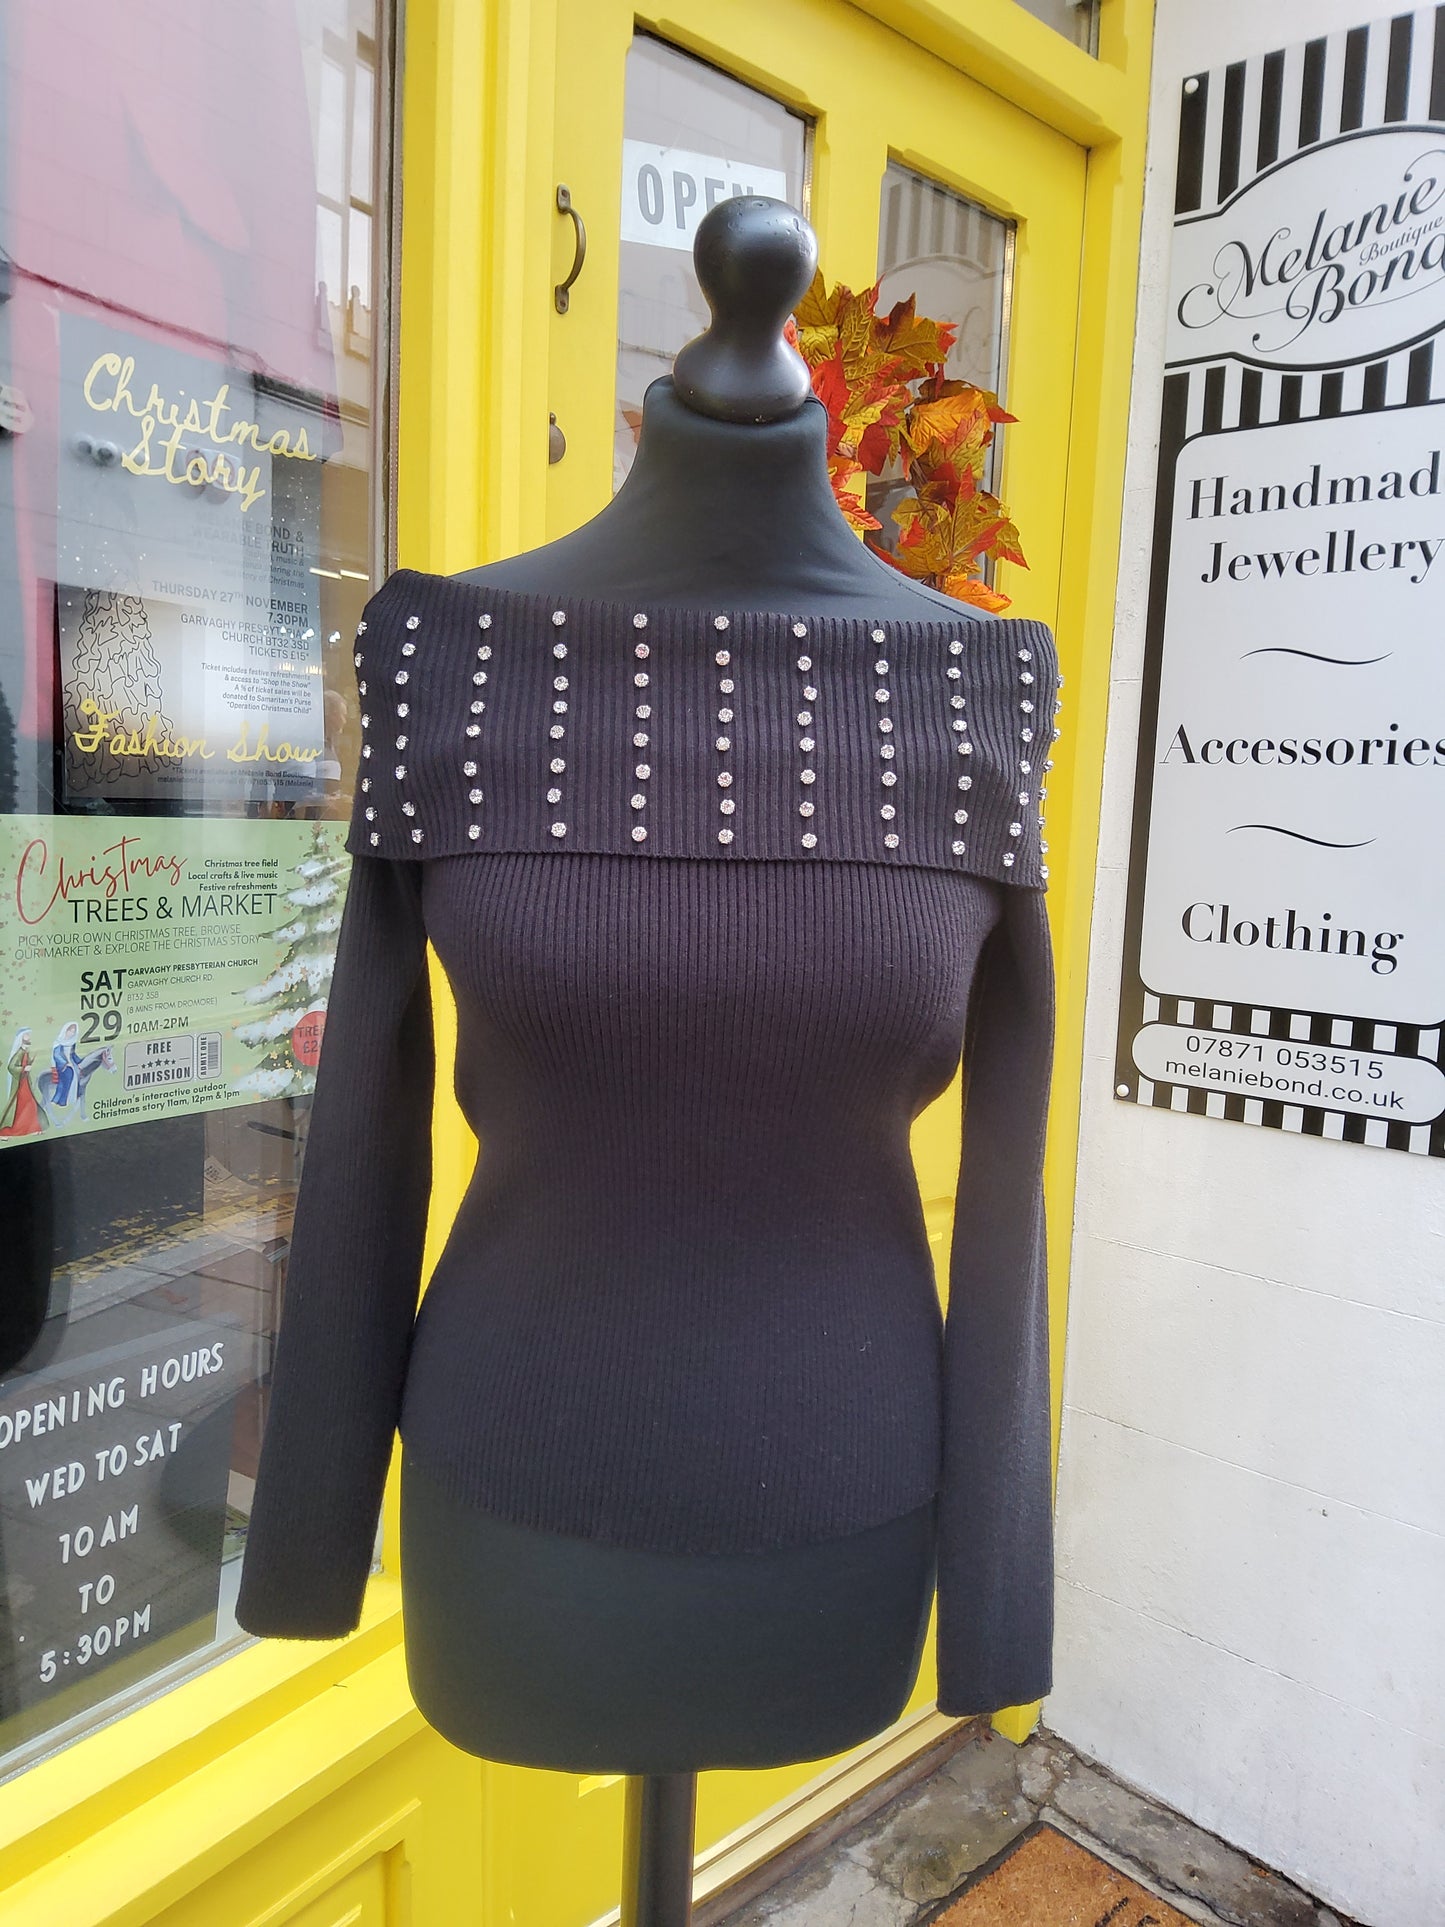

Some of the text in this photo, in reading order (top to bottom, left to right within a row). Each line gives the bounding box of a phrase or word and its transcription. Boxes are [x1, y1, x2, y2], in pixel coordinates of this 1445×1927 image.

[637, 163, 754, 230] OPE
[1178, 150, 1445, 328] Melanie
[1359, 215, 1444, 266] Boutique
[84, 353, 317, 461] Christmas
[121, 415, 266, 512] Story
[1186, 450, 1442, 520] Handmad
[255, 522, 291, 540] BOND
[295, 531, 304, 543] &
[1200, 529, 1445, 584] Jewellery
[152, 580, 217, 600] THURSDAY
[246, 595, 308, 614] NOVEMBER
[181, 613, 235, 630] GARVAGHY
[267, 612, 308, 628] 7.30PM
[222, 631, 263, 646] CHURCH
[266, 635, 289, 649] BT32
[249, 646, 288, 660] TICKETS
[201, 662, 311, 681] Ticket includes festive refreshments
[230, 675, 252, 683] access
[281, 679, 291, 687] the
[222, 692, 311, 706] donated to Samaritan's Purse
[247, 685, 255, 693] of
[255, 686, 273, 694] ticket
[274, 688, 290, 696] sales
[292, 689, 302, 697] will
[303, 690, 311, 698] be
[261, 705, 292, 713] Christmas
[73, 698, 322, 763] Fashion Show
[1159, 722, 1445, 767] Accessories
[188, 871, 208, 880] Local
[210, 871, 232, 879] crafts
[241, 871, 254, 879] live
[256, 870, 278, 879] music
[204, 859, 243, 868] Christmas
[261, 859, 278, 867] field
[17, 836, 188, 924] Christmas
[199, 882, 278, 891] Festive refreshments
[68, 893, 278, 923] TREES & MARKET
[18, 934, 44, 947] PICK
[46, 932, 80, 945] YOUR
[82, 931, 112, 944] OWN
[114, 928, 170, 942] CHRISTMAS
[200, 924, 241, 936] BROWSE
[1181, 902, 1404, 975] Clothing
[14, 949, 41, 960] OUR
[43, 945, 91, 958] MARKET
[93, 945, 102, 955] &
[105, 941, 150, 955] EXPLORE
[153, 940, 171, 950] THE
[173, 937, 228, 949] CHRISTMAS
[127, 958, 258, 976] GARVAGHY PRESBYTERIAN CHURCH
[80, 969, 127, 992] SAT
[127, 977, 169, 989] GARVAGHY
[170, 974, 201, 985] CHURCH
[80, 992, 123, 1010] NOV
[126, 997, 218, 1015] (8 MINS FROM DROMORE)
[80, 1010, 122, 1044] 29
[127, 1016, 189, 1034] 10AM-2PM
[297, 1024, 324, 1038] TRE
[146, 1041, 172, 1055] FREE
[303, 1040, 320, 1054] £2
[1186, 1034, 1384, 1080] 07871 053515
[127, 1067, 191, 1087] ADMISSION
[1165, 1058, 1405, 1110] melaniebond.co.uk
[93, 1083, 227, 1110] Children's interactive outdoor
[93, 1106, 140, 1120] Christmas
[142, 1102, 165, 1112] story
[167, 1098, 190, 1108] 11am,
[192, 1095, 213, 1106] 12pm
[224, 1090, 240, 1100] 1pm
[0, 1342, 225, 1449] OPENING HOURS
[25, 1422, 183, 1508] WED TO SAT
[78, 1574, 116, 1614] TO
[39, 1604, 152, 1683] 5:30PM
